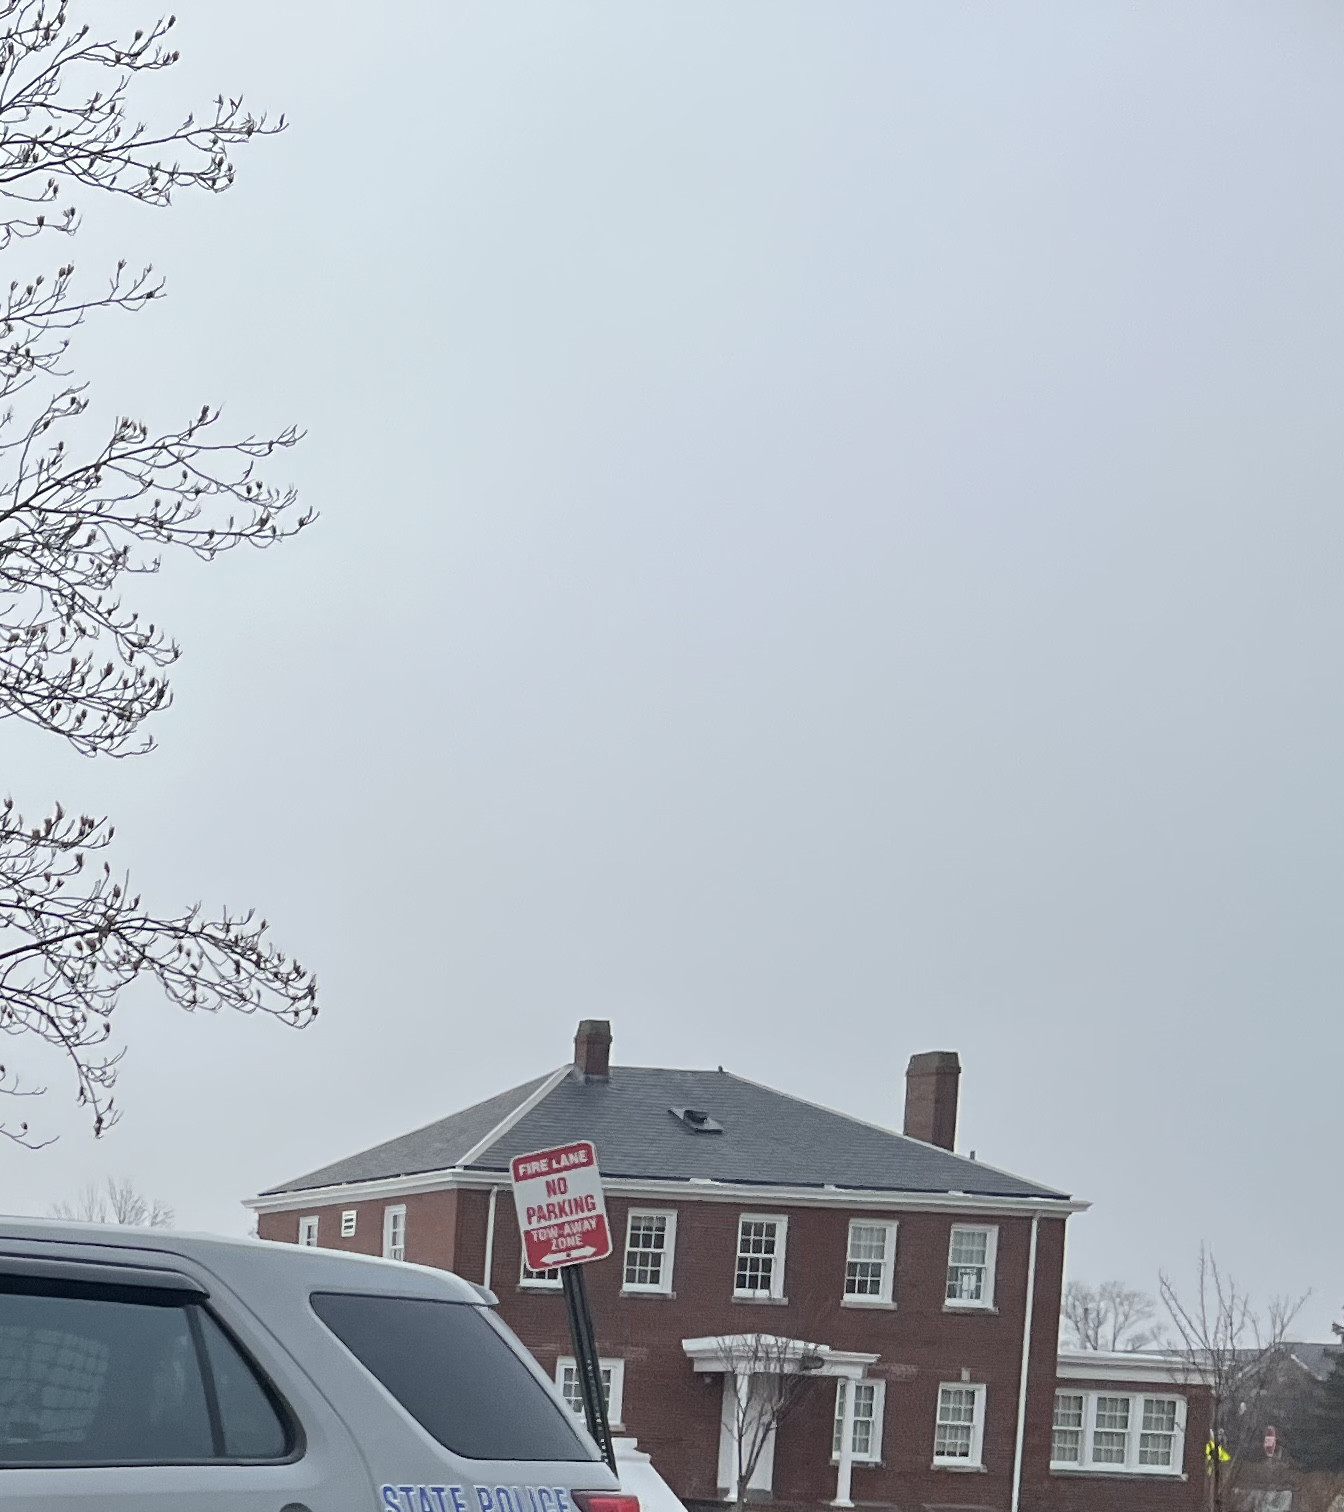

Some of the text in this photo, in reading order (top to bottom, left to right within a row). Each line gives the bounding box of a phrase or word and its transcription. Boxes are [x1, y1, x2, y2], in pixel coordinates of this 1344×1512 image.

[519, 1150, 588, 1176] FIRE LANE
[545, 1178, 568, 1197] NO
[526, 1194, 597, 1225] PARKING
[530, 1217, 598, 1243] TOW-AWAY
[551, 1235, 583, 1251] ZONE
